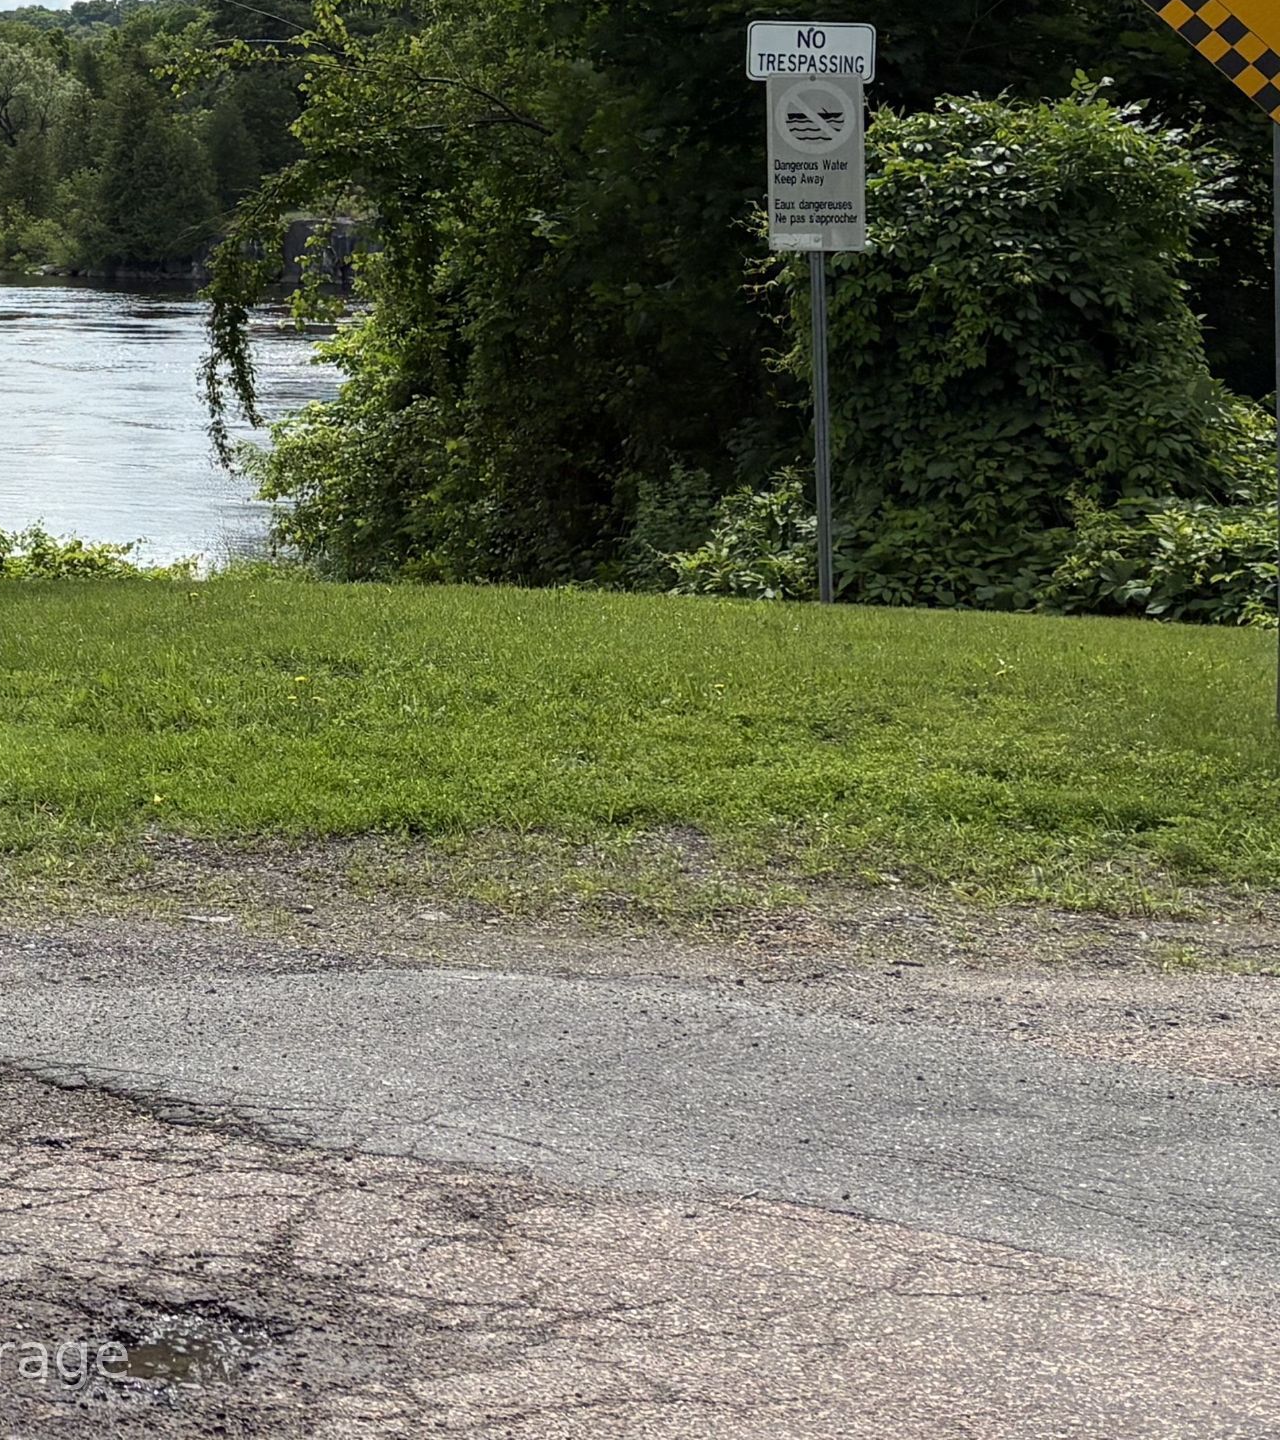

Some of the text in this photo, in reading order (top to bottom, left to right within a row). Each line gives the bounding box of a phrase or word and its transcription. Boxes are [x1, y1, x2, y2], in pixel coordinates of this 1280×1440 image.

[797, 30, 826, 49] NO
[757, 53, 865, 74] TRESPASSING
[774, 159, 848, 172] Dangerous Water
[774, 173, 825, 186] Keep Away
[774, 199, 853, 213] Eaux dangereuses
[775, 213, 858, 226] Ne pas s'approcher
